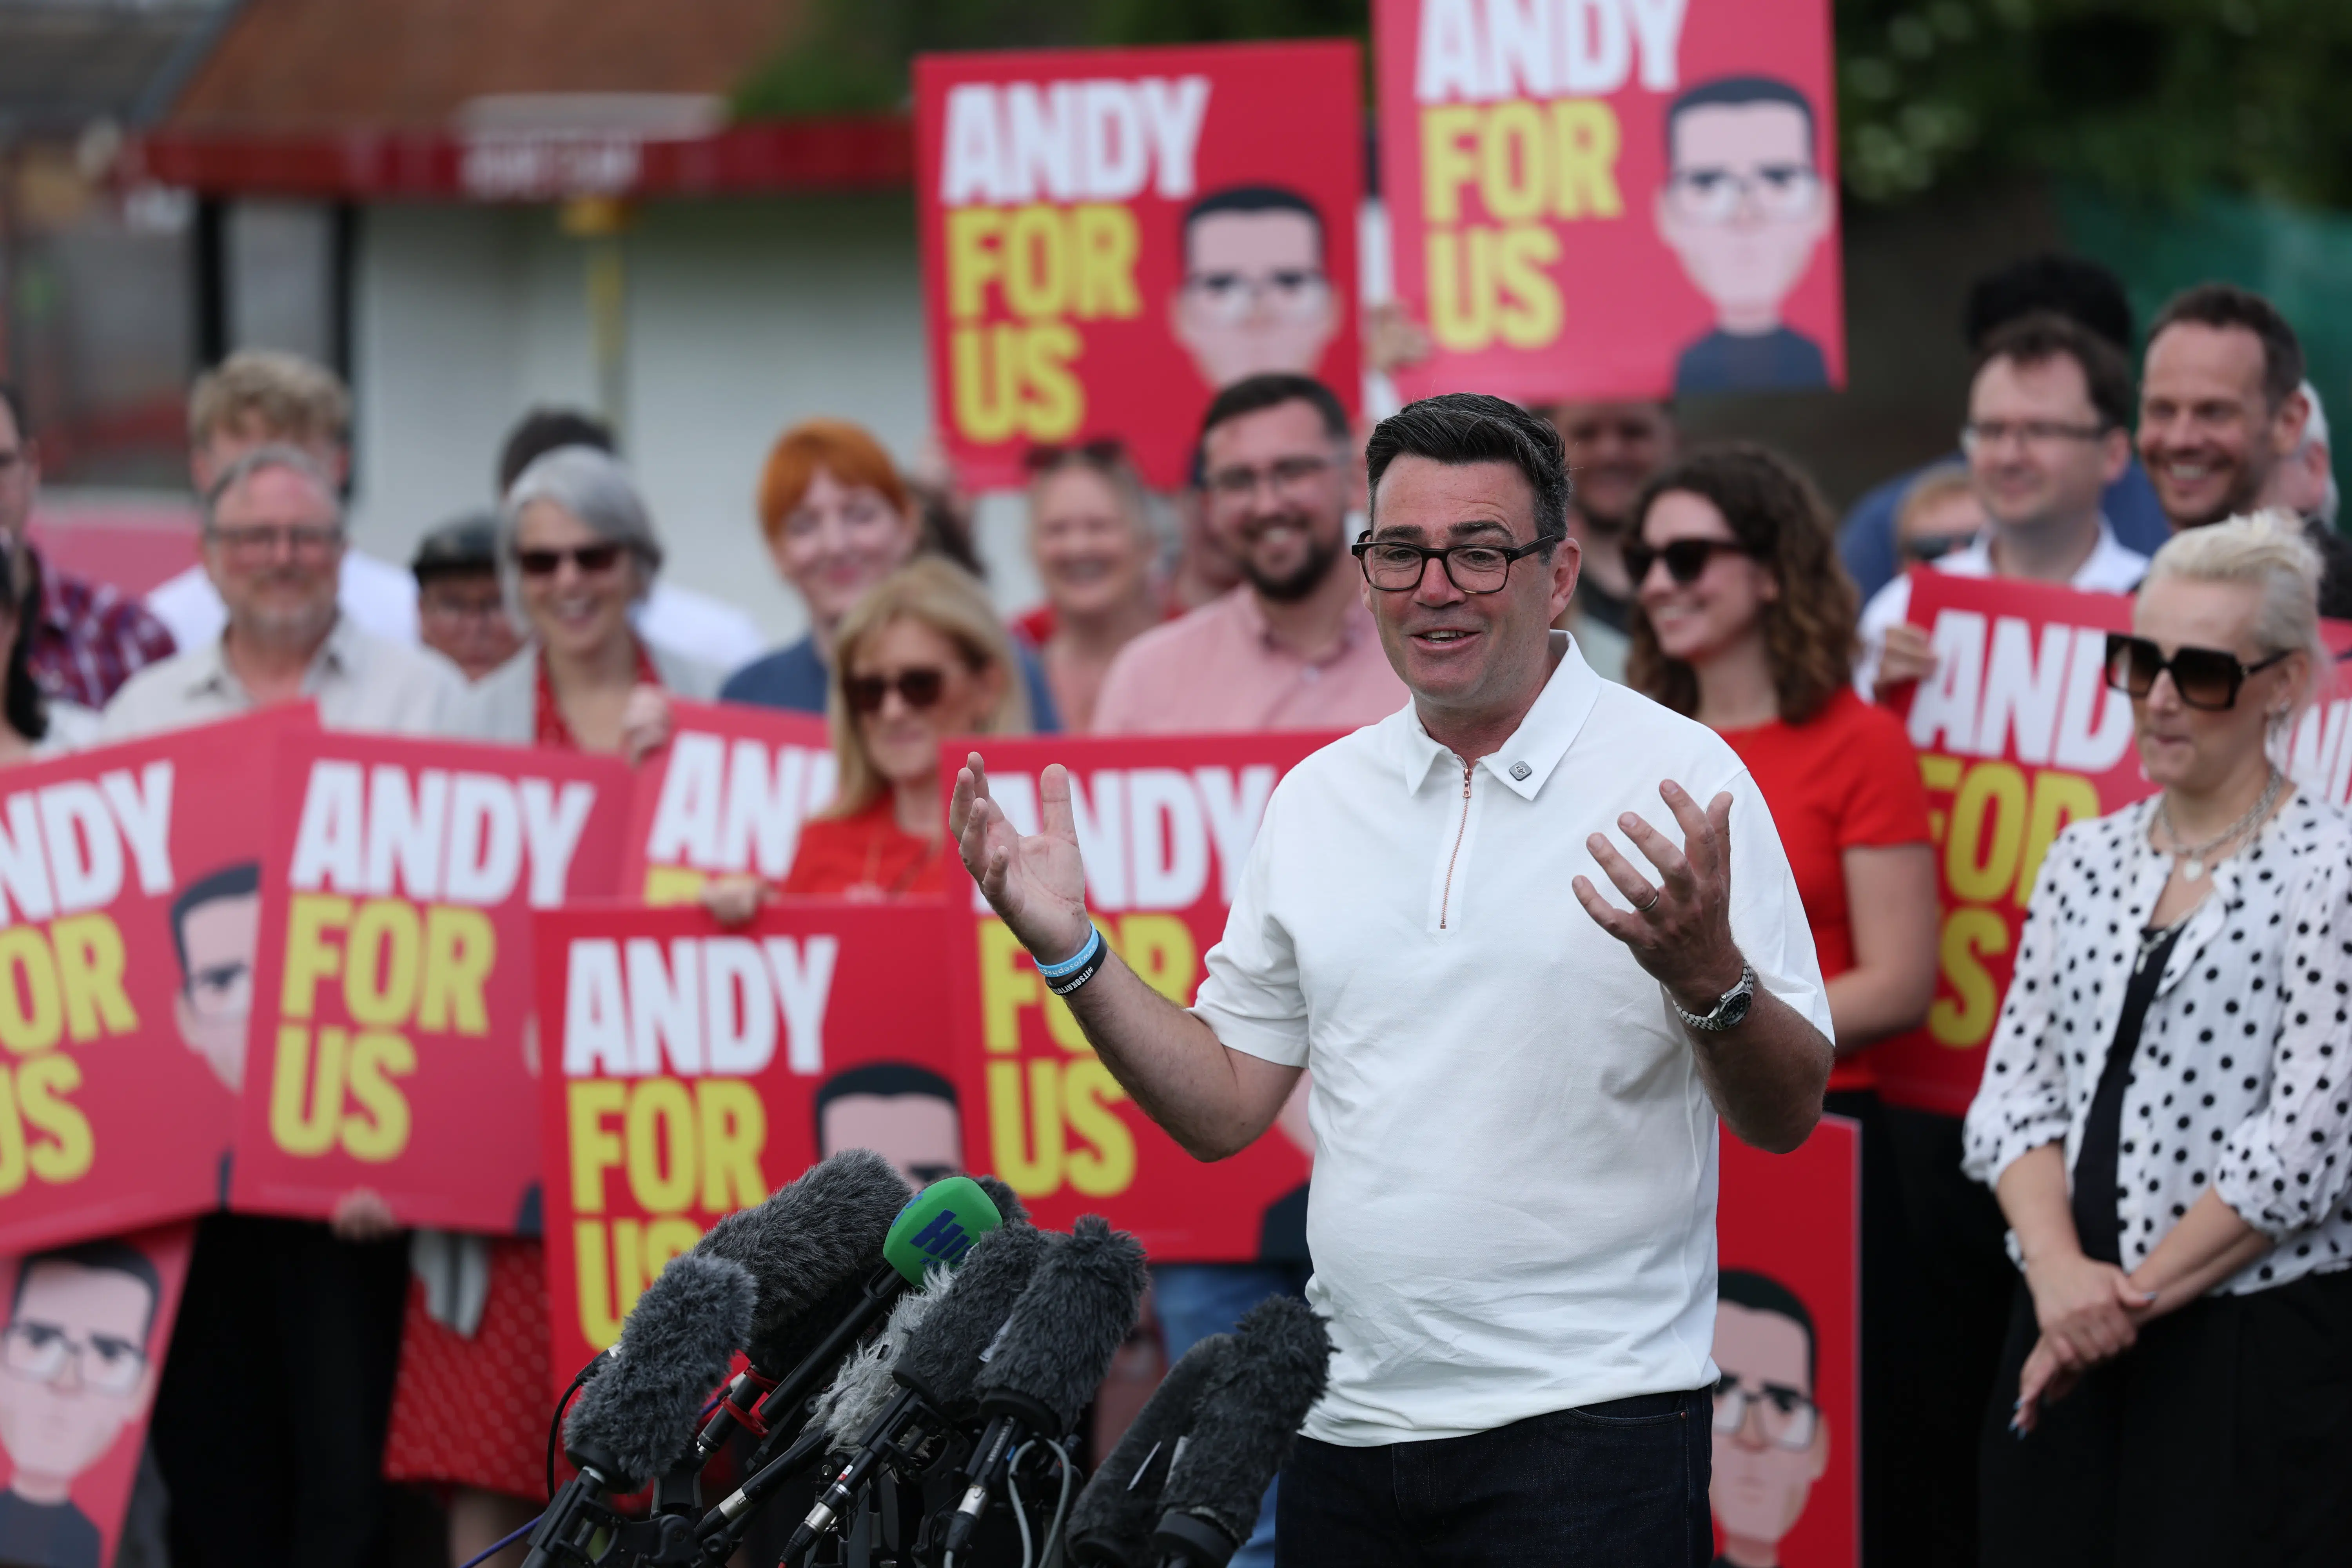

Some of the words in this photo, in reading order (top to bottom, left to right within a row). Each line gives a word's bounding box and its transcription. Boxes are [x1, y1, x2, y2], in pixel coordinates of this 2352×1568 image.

[1414, 0, 1689, 99] ANDY
[942, 76, 1210, 206] ANDY
[1422, 99, 1621, 222] FOR
[946, 202, 1141, 321] FOR
[1429, 226, 1563, 350] US
[952, 324, 1085, 442] US
[1907, 607, 2141, 774] AND
[0, 758, 175, 930] NDY
[288, 757, 596, 909] ANDY
[0, 912, 138, 1055] OR
[280, 892, 495, 1036] FOR
[562, 936, 838, 1075] ANDY
[270, 1025, 417, 1160] US
[566, 1076, 768, 1214] FOR
[986, 1059, 1138, 1197] US
